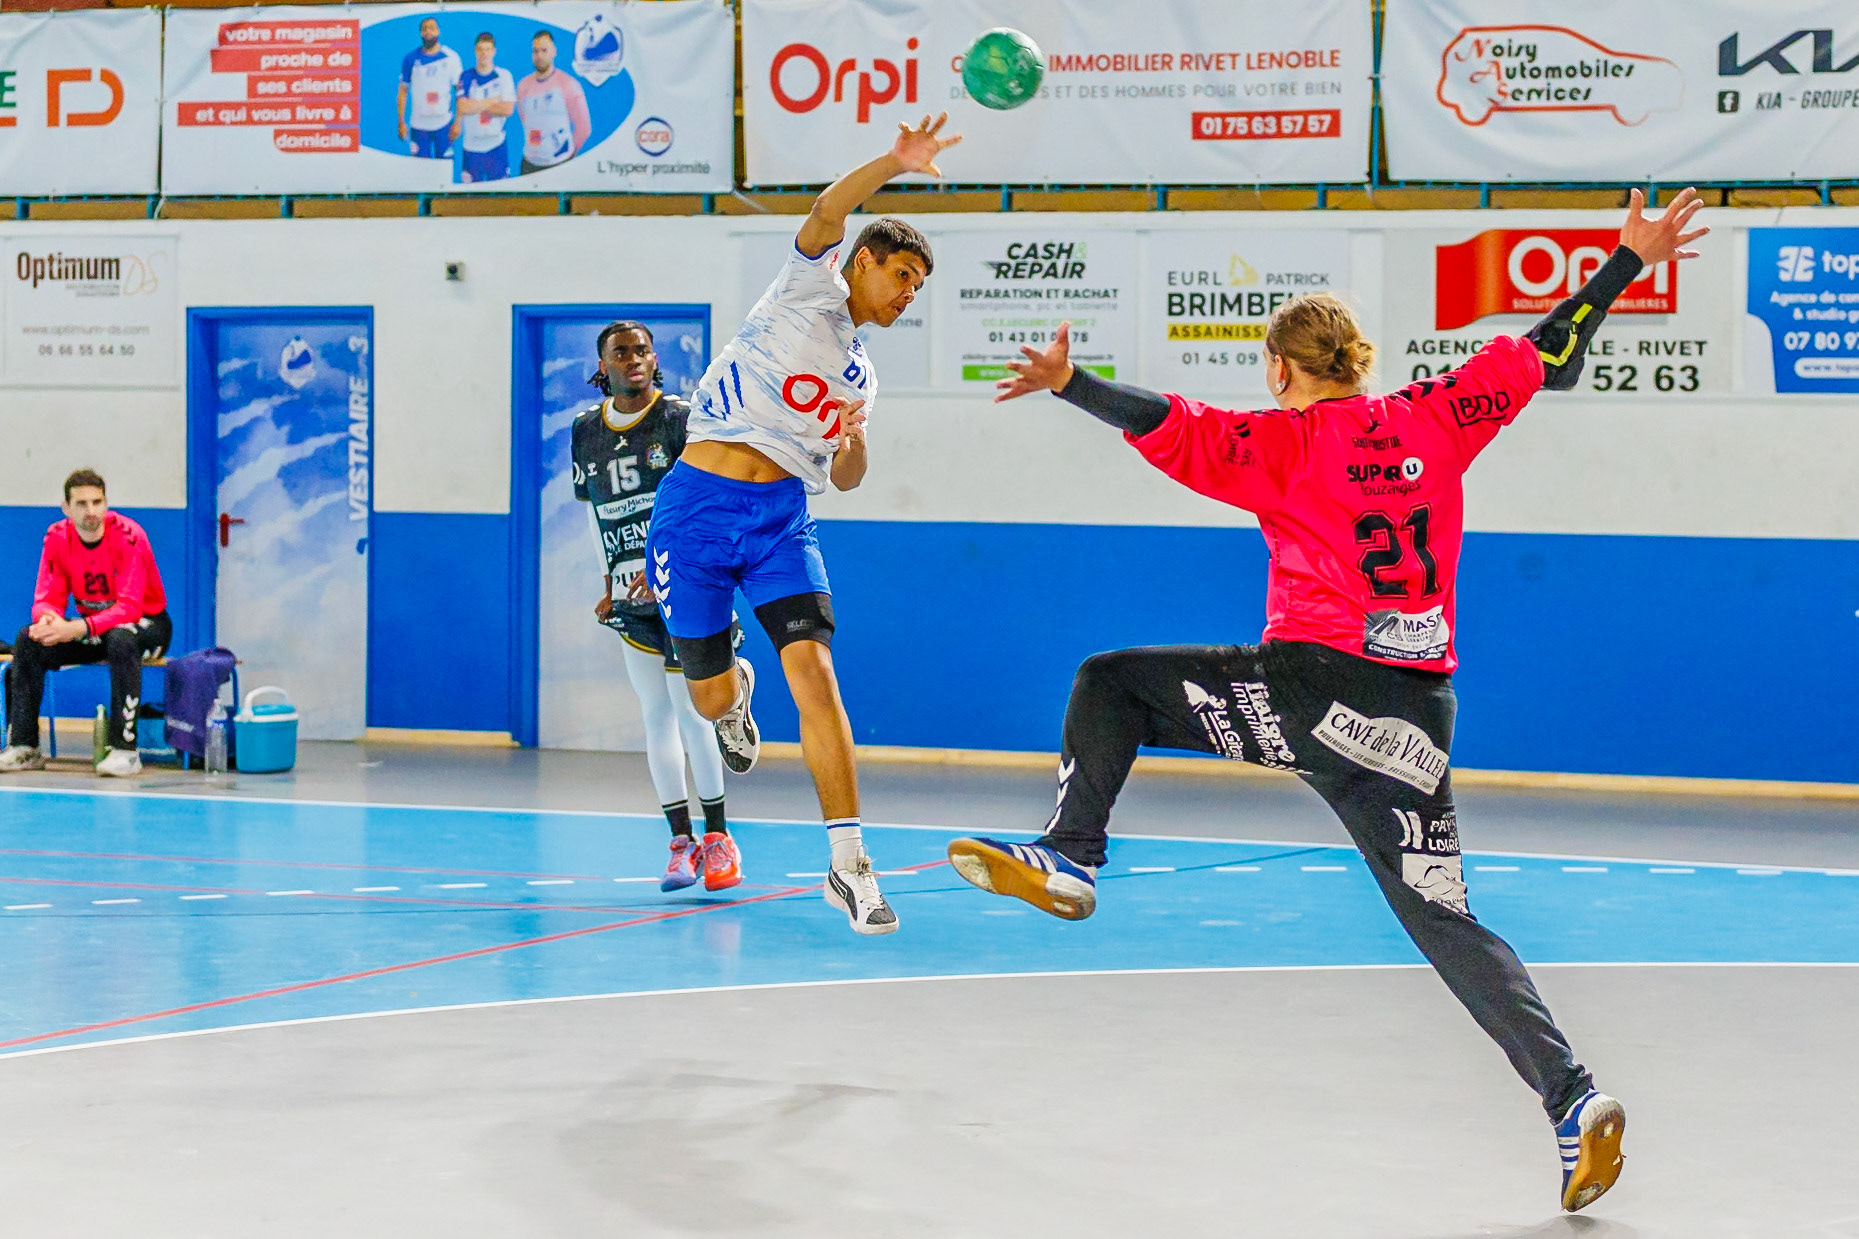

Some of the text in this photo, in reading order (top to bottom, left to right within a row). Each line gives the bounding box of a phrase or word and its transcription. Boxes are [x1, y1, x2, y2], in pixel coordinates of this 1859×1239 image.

[225, 25, 353, 43] votre magasin
[1454, 39, 1537, 63] Noisy
[260, 51, 353, 71] proche de
[1050, 50, 1341, 72] IMMOBILIER RIVET LENOBLE
[770, 37, 919, 123] Orpi
[1469, 60, 1634, 83] Automobiles
[256, 78, 353, 94] ses clients
[1055, 86, 1072, 99] ET
[1078, 85, 1109, 98] DES
[1115, 84, 1186, 98] HOMMES
[1194, 84, 1236, 97] POUR
[1243, 82, 1297, 96] VOTRE
[1305, 82, 1342, 95] BIEN
[1488, 82, 1592, 104] Services
[1756, 91, 1782, 110] KIA
[196, 104, 352, 125] et qui vous livre à
[1251, 115, 1277, 134] 63
[1280, 115, 1304, 134] 57
[1307, 114, 1332, 133] 57
[276, 133, 352, 148] domicile
[638, 130, 670, 143] cora
[652, 160, 711, 176] proximité
[1007, 243, 1074, 260] CASH
[17, 252, 120, 288] Optimum
[995, 262, 1086, 279] REPAIR
[1168, 271, 1330, 286] EURL PATRICK
[960, 288, 1118, 299] REPARATION ET RACHAT
[1770, 291, 1817, 307] Agence
[1819, 290, 1837, 304] de
[1168, 292, 1293, 317] BRIMBE
[1805, 307, 1847, 321] studio
[989, 332, 1004, 342] 01
[1009, 332, 1026, 342] 43
[1031, 332, 1046, 342] 01
[1169, 326, 1266, 339] ASSAINISS
[1784, 331, 1811, 350] 07
[1814, 331, 1841, 350] 80
[1406, 340, 1485, 355] AGENC
[1638, 341, 1707, 356] RIVET
[1182, 352, 1259, 365] 01 45 09
[1593, 365, 1637, 392] 52
[1655, 365, 1699, 392] 63
[1458, 391, 1511, 419] BDO
[349, 336, 368, 520] VESTIAIRE 3
[607, 455, 641, 495] 15
[1405, 463, 1418, 475] U
[627, 495, 655, 510] Micho
[624, 538, 646, 551] DÉPA
[1353, 502, 1442, 600] 21
[1213, 711, 1231, 730] La
[1330, 712, 1377, 746] CAVE
[1370, 729, 1389, 753] de
[1385, 731, 1401, 757] la
[1428, 837, 1460, 852] LOIRE
